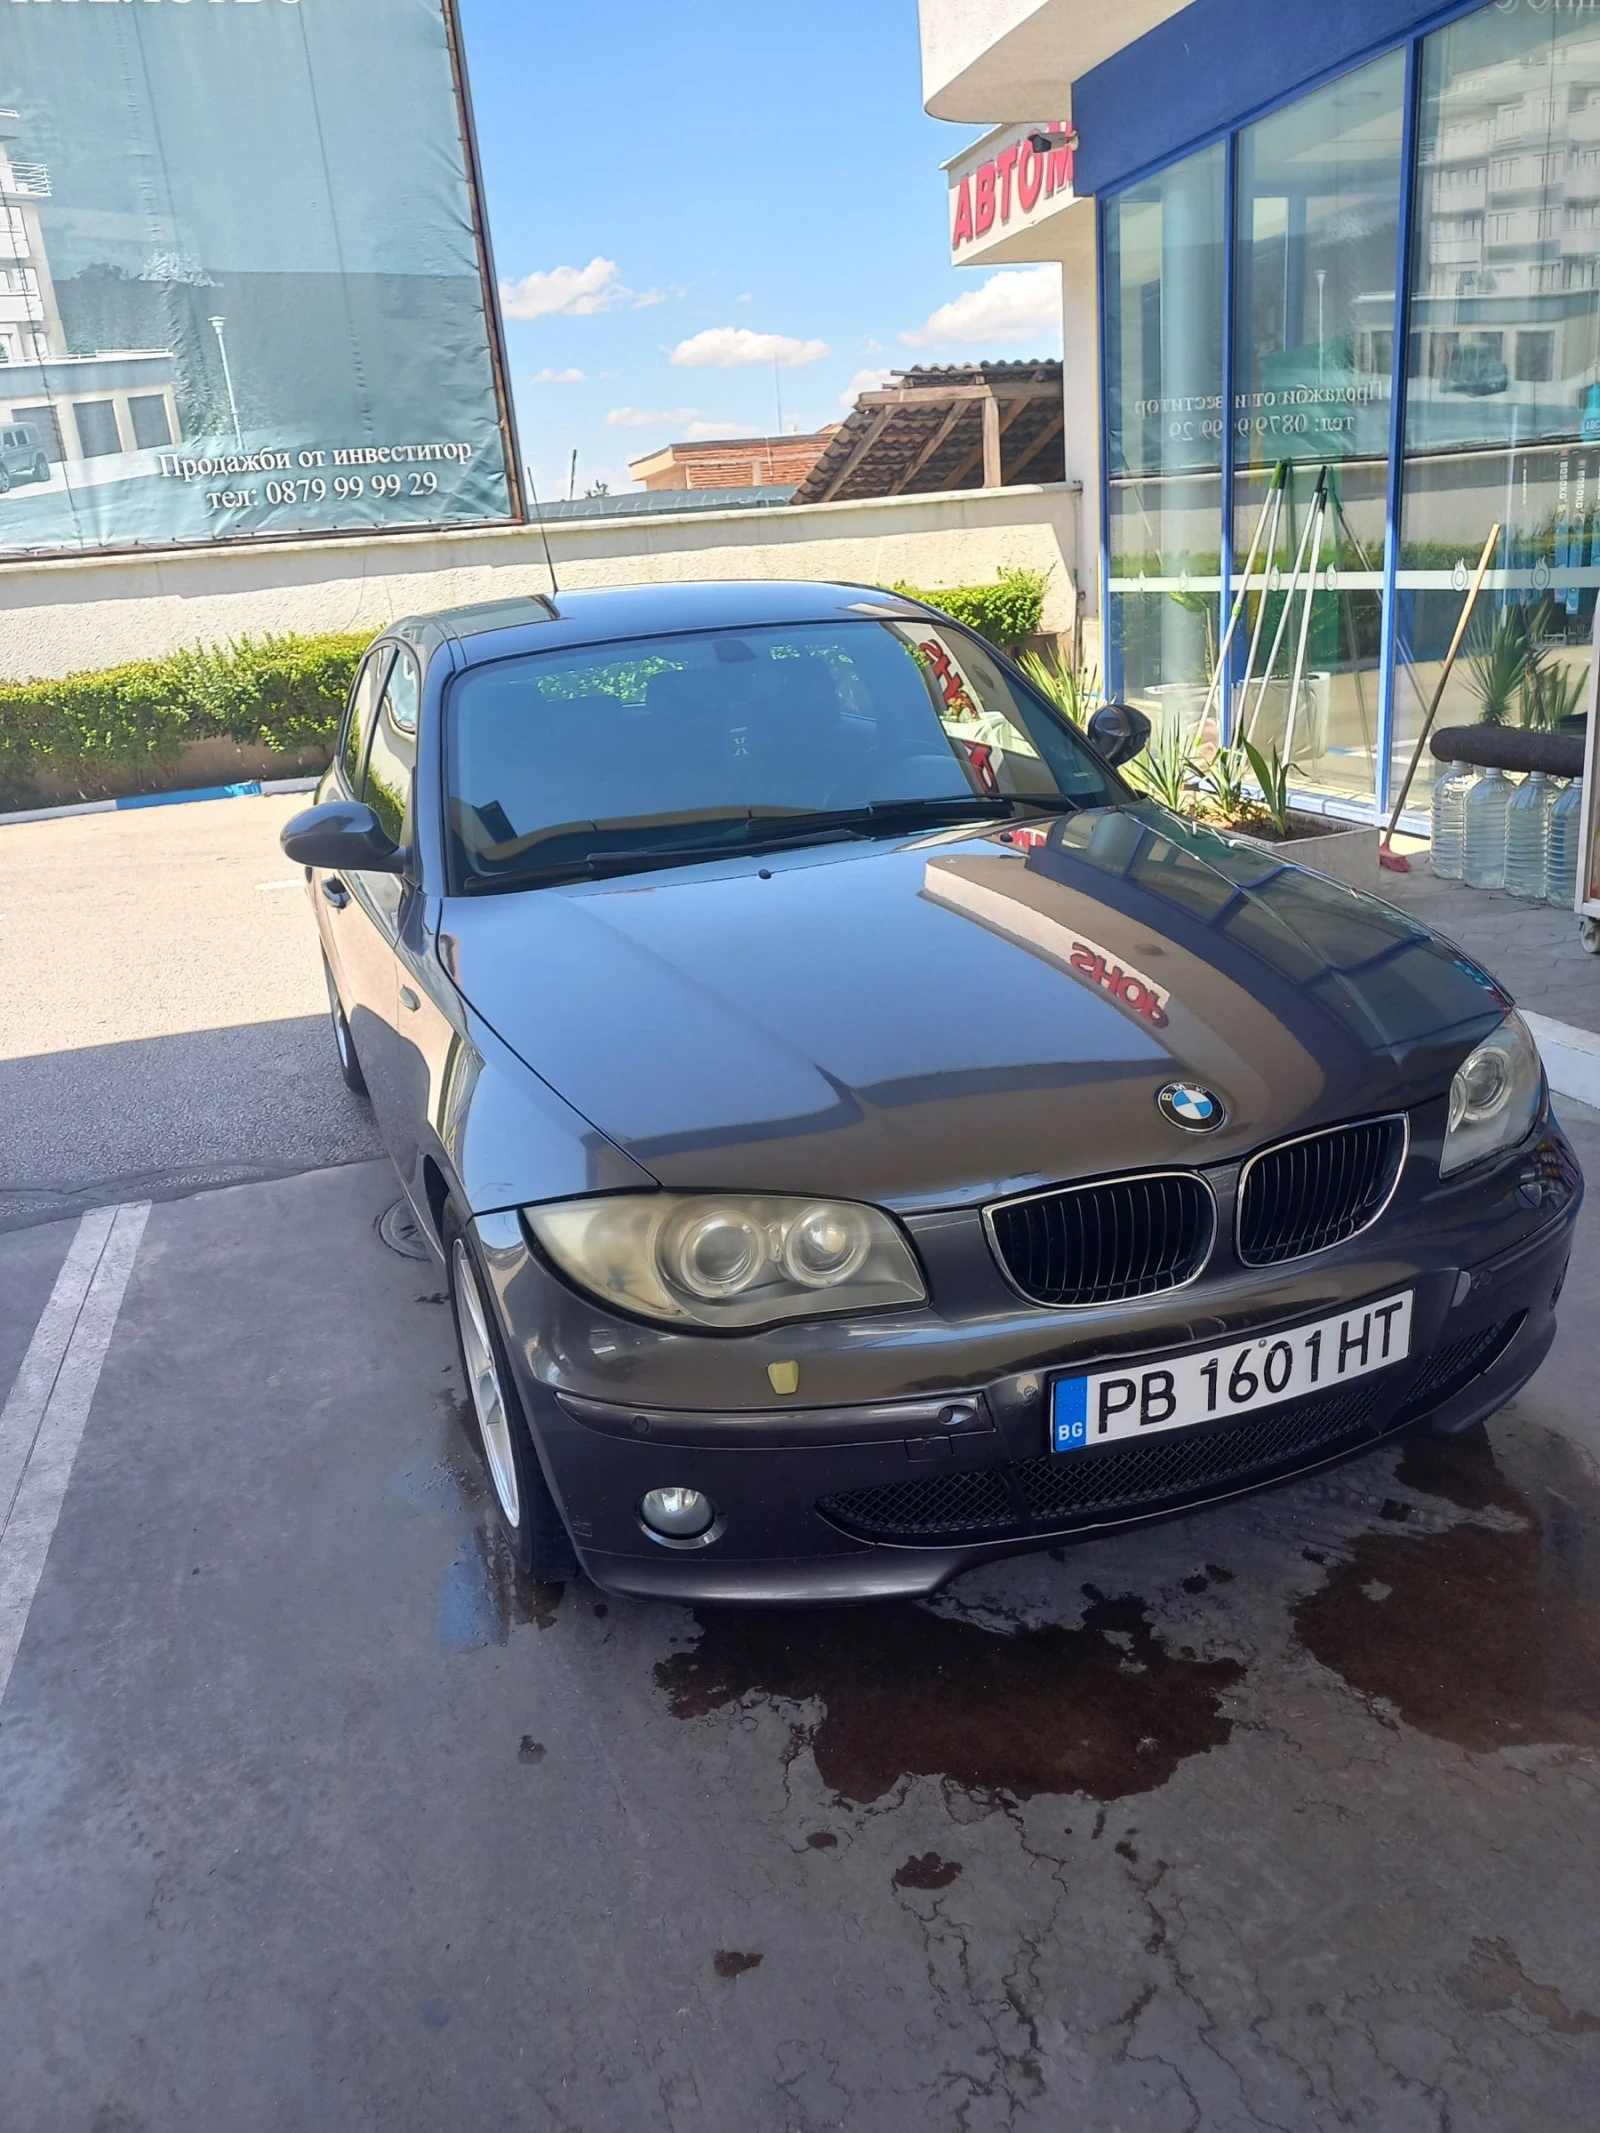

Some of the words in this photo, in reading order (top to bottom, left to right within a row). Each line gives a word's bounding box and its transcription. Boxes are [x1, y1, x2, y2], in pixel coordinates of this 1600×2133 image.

[158, 447, 291, 482] Продажби
[298, 450, 325, 468] от
[333, 441, 473, 466] инвеститор
[206, 487, 259, 510] тел:
[265, 478, 327, 505] 0879
[333, 475, 364, 500] 99
[371, 473, 401, 498] 99
[407, 471, 438, 496] 29
[1161, 1084, 1208, 1101] BMW
[1098, 1370, 1177, 1434] PB
[1200, 1329, 1322, 1412] 1601
[1337, 1300, 1403, 1374] HT
[1058, 1421, 1084, 1441] BG
